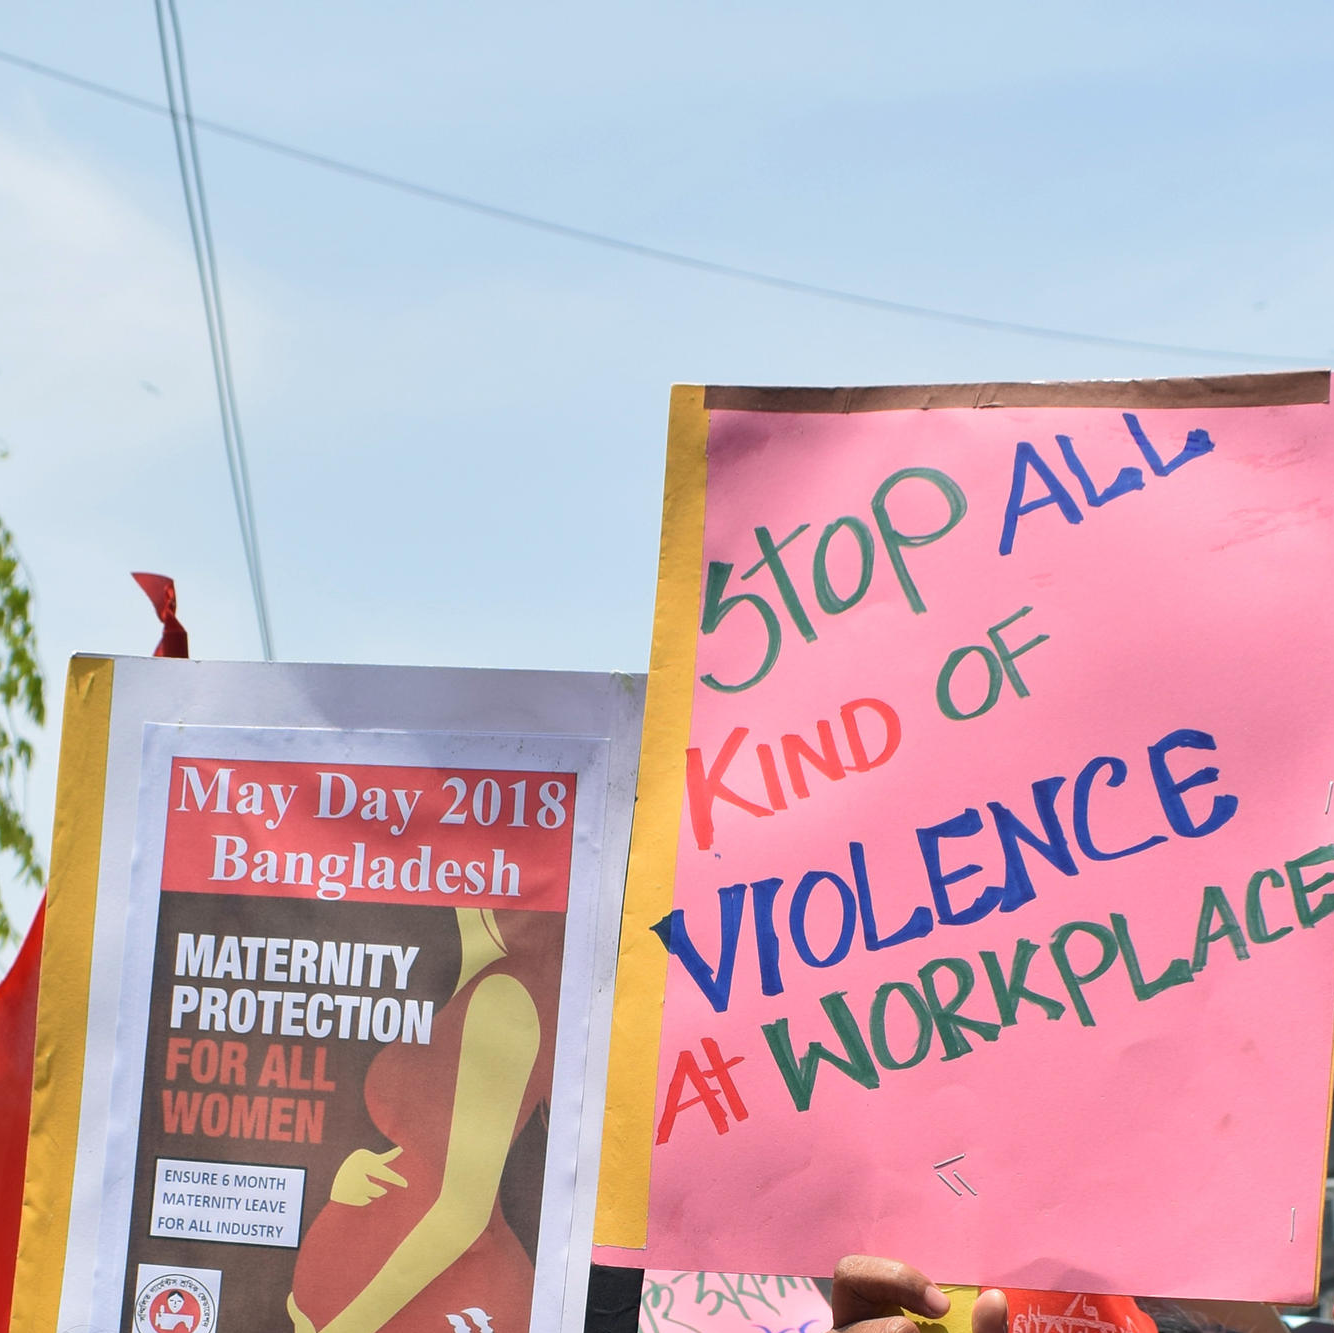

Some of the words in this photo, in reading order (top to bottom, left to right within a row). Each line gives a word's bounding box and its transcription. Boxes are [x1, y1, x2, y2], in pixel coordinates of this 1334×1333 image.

[999, 413, 1216, 556] ALL
[686, 697, 902, 851] KIND
[936, 606, 1049, 721] OF
[178, 765, 298, 829] May
[316, 771, 423, 835] Day
[440, 776, 569, 829] 2018
[208, 835, 523, 900] Bangladesh
[650, 729, 1238, 1013] VIOLENCE
[175, 933, 420, 990] MATERNITY
[169, 984, 435, 1045] PROTECTION
[165, 1036, 247, 1088] FOR
[257, 1042, 336, 1092] ALL
[162, 1090, 326, 1145] WOMEN
[162, 1192, 242, 1211] MATERNITY
[244, 1196, 287, 1214] LEAVE
[165, 1169, 218, 1186] ENSURE
[222, 1174, 230, 1186] 6
[233, 1175, 286, 1191] MONTH
[157, 1216, 185, 1231] FOR
[188, 1219, 212, 1233] ALL
[216, 1221, 284, 1239] INDUSTRY
